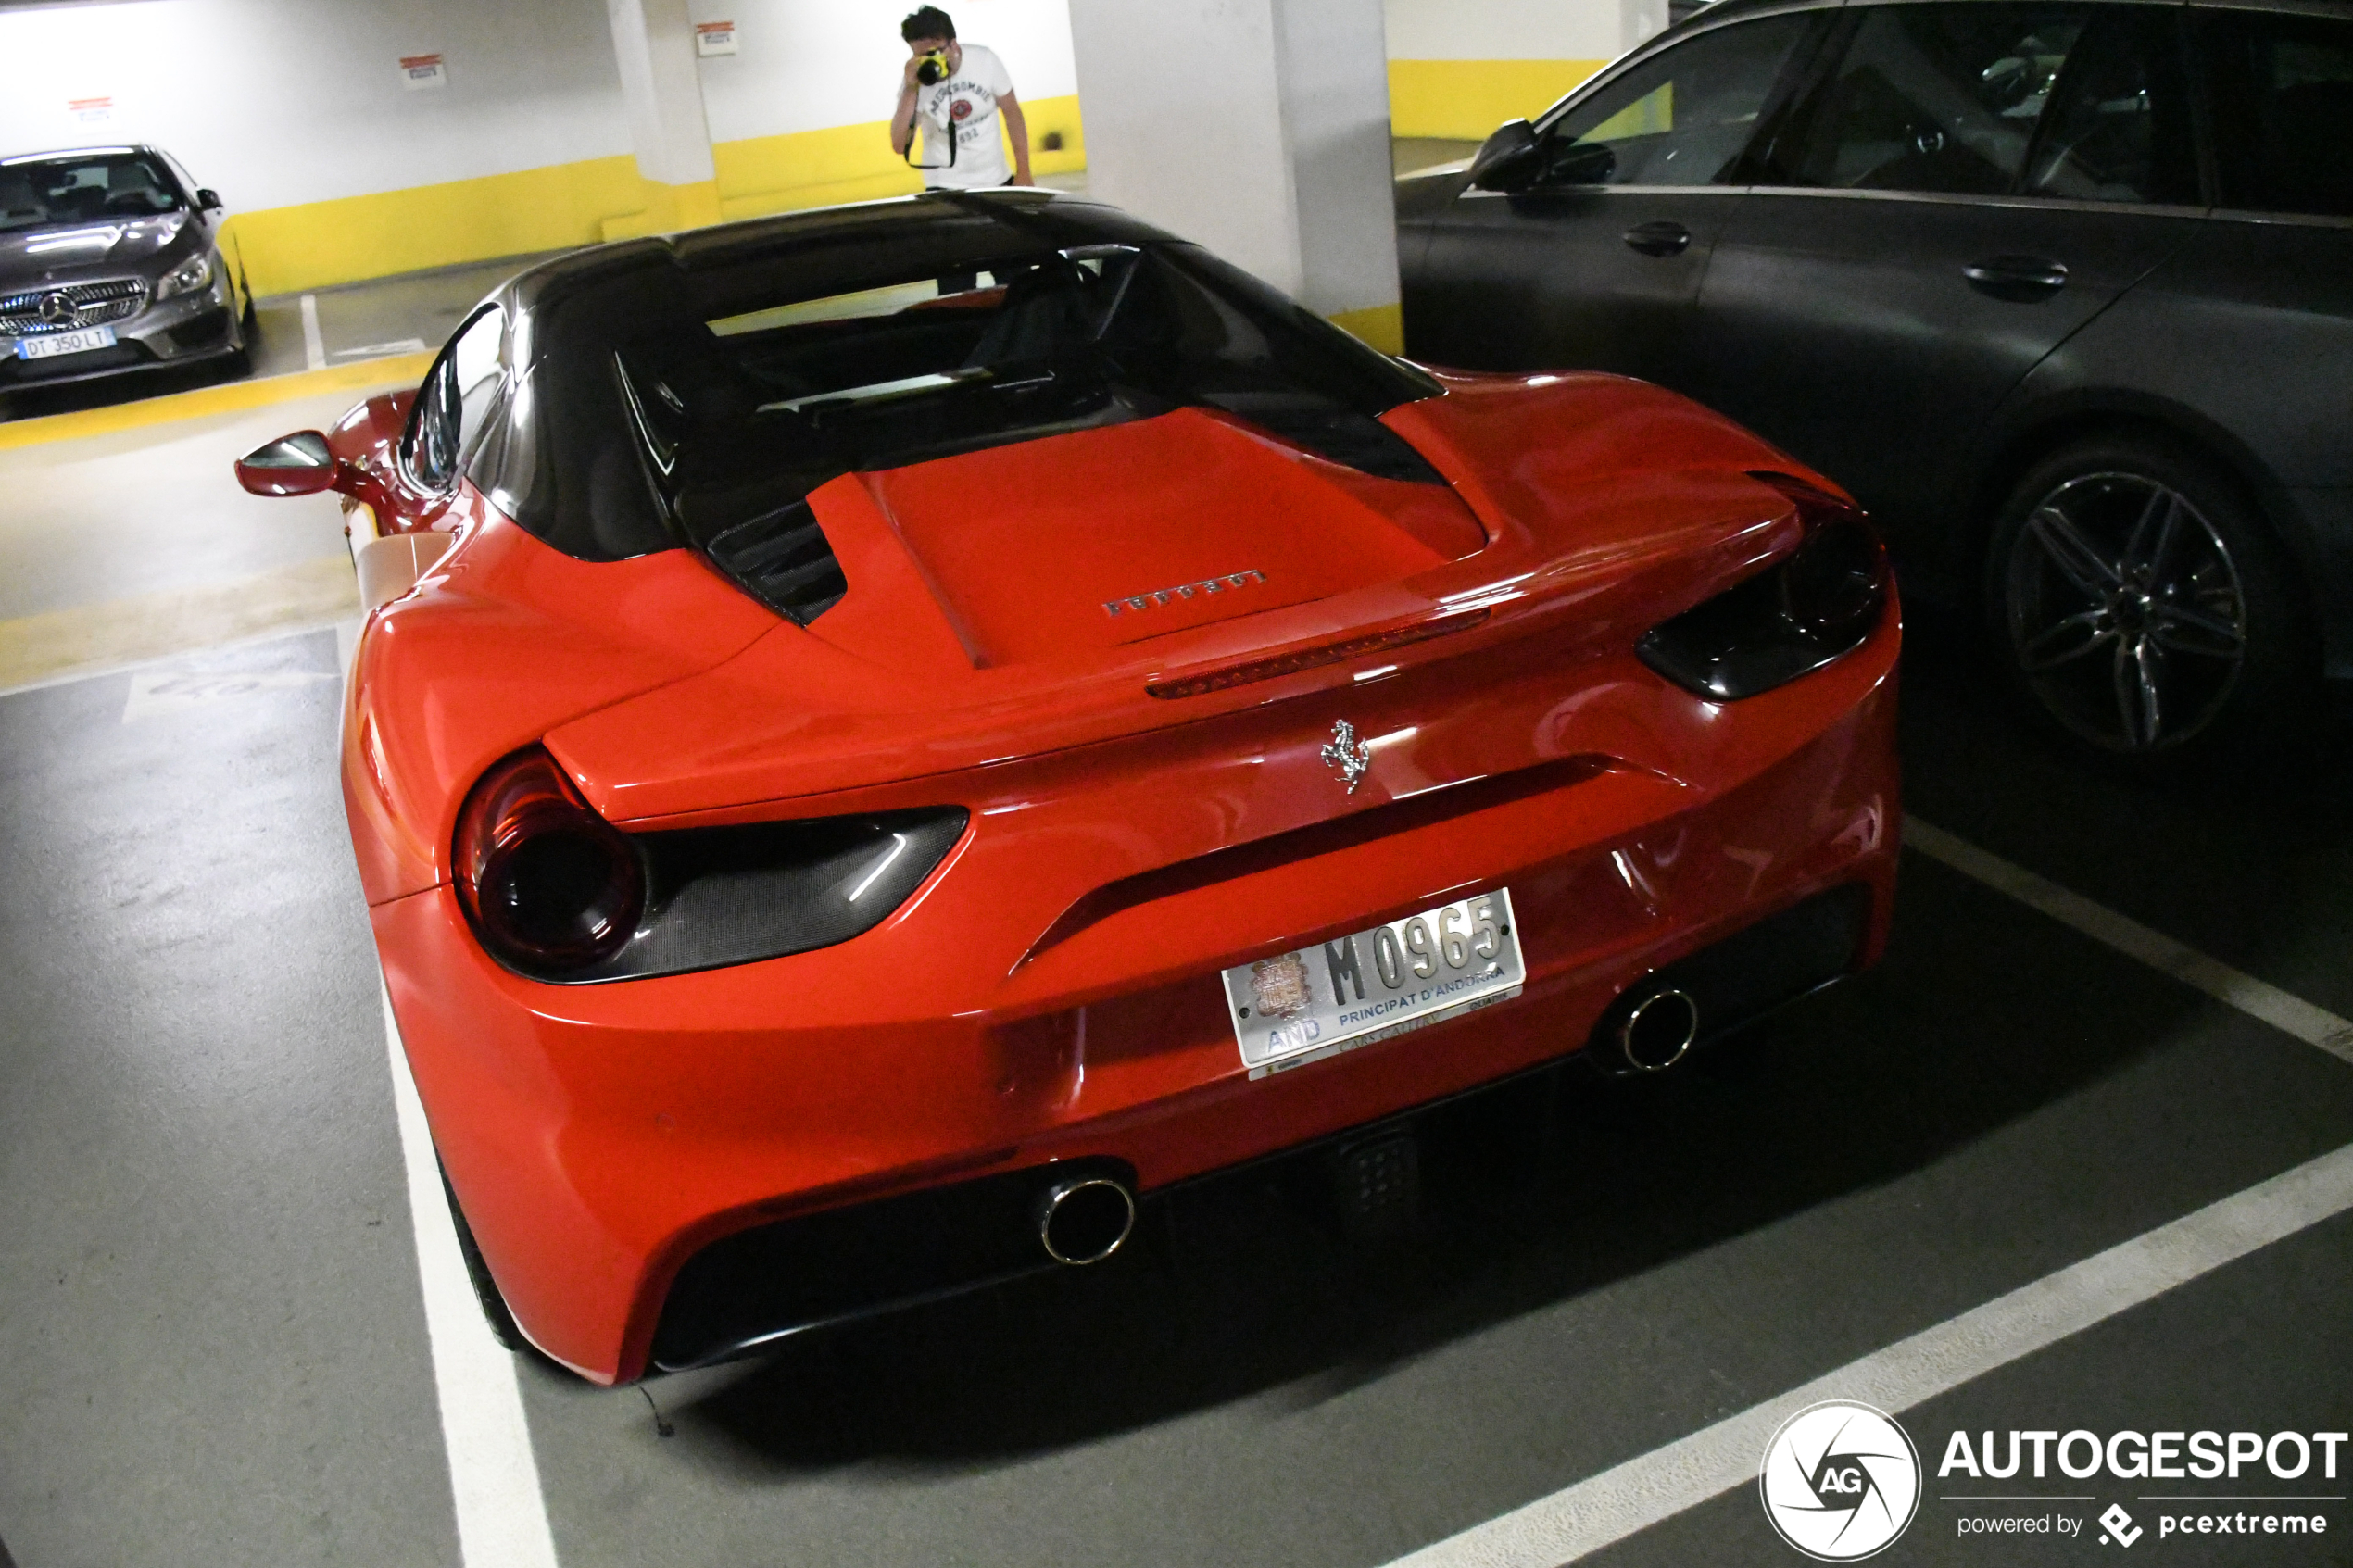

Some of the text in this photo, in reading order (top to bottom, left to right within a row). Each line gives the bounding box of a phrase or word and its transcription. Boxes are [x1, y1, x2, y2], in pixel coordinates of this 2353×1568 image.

[1101, 569, 1266, 617] FERRARI
[1339, 966, 1505, 1026] PRINCIPAT D'ANDORRA
[1268, 1020, 1320, 1052] AND
